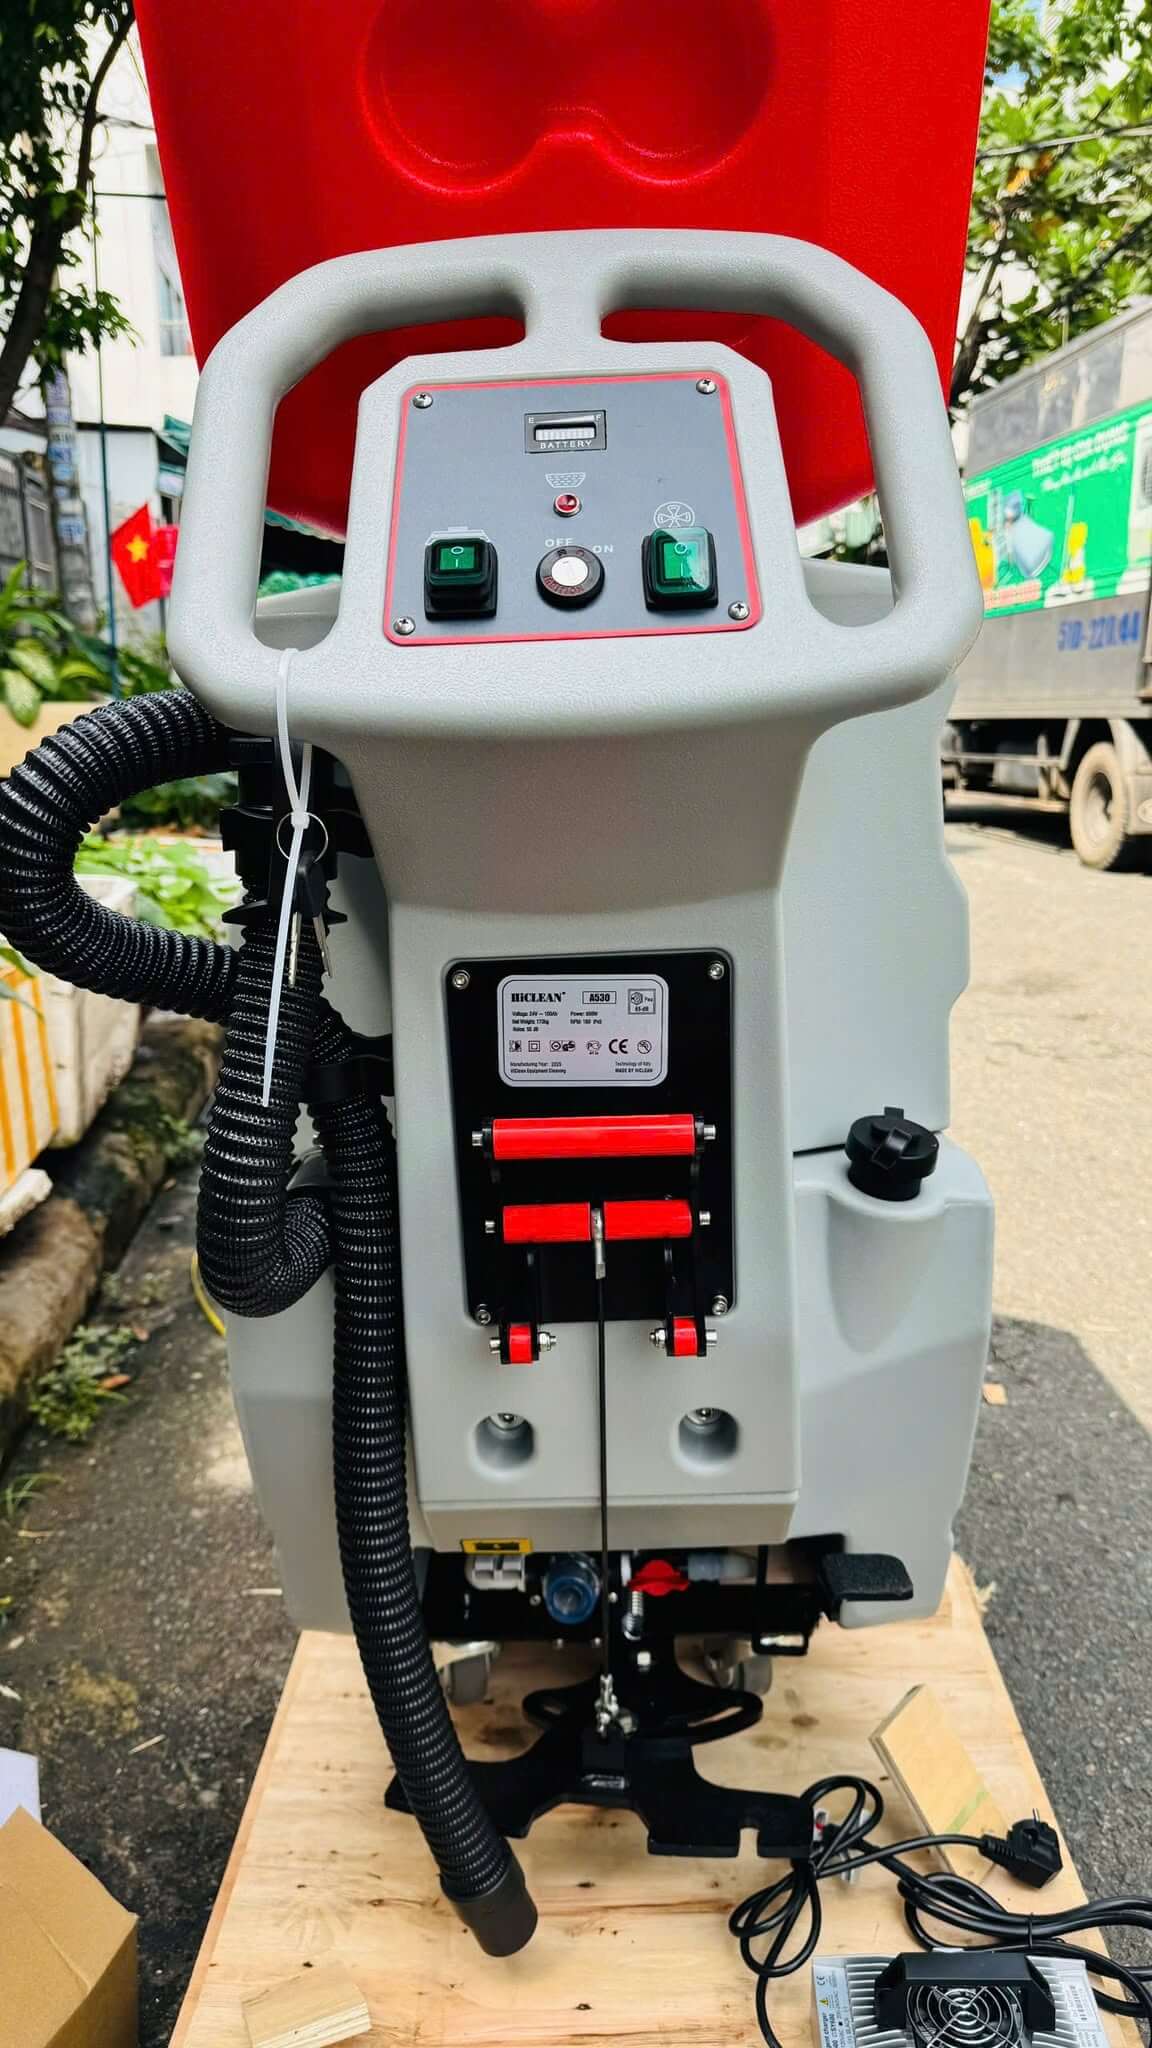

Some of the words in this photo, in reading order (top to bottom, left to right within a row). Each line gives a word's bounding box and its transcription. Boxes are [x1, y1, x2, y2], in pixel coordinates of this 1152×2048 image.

[595, 414, 602, 422] F
[540, 440, 593, 449] BATTERY
[544, 537, 574, 547] OFF
[592, 544, 614, 553] ON
[511, 992, 562, 1003] HiCLEAN
[589, 993, 610, 1002] A530
[609, 1039, 629, 1054] CE
